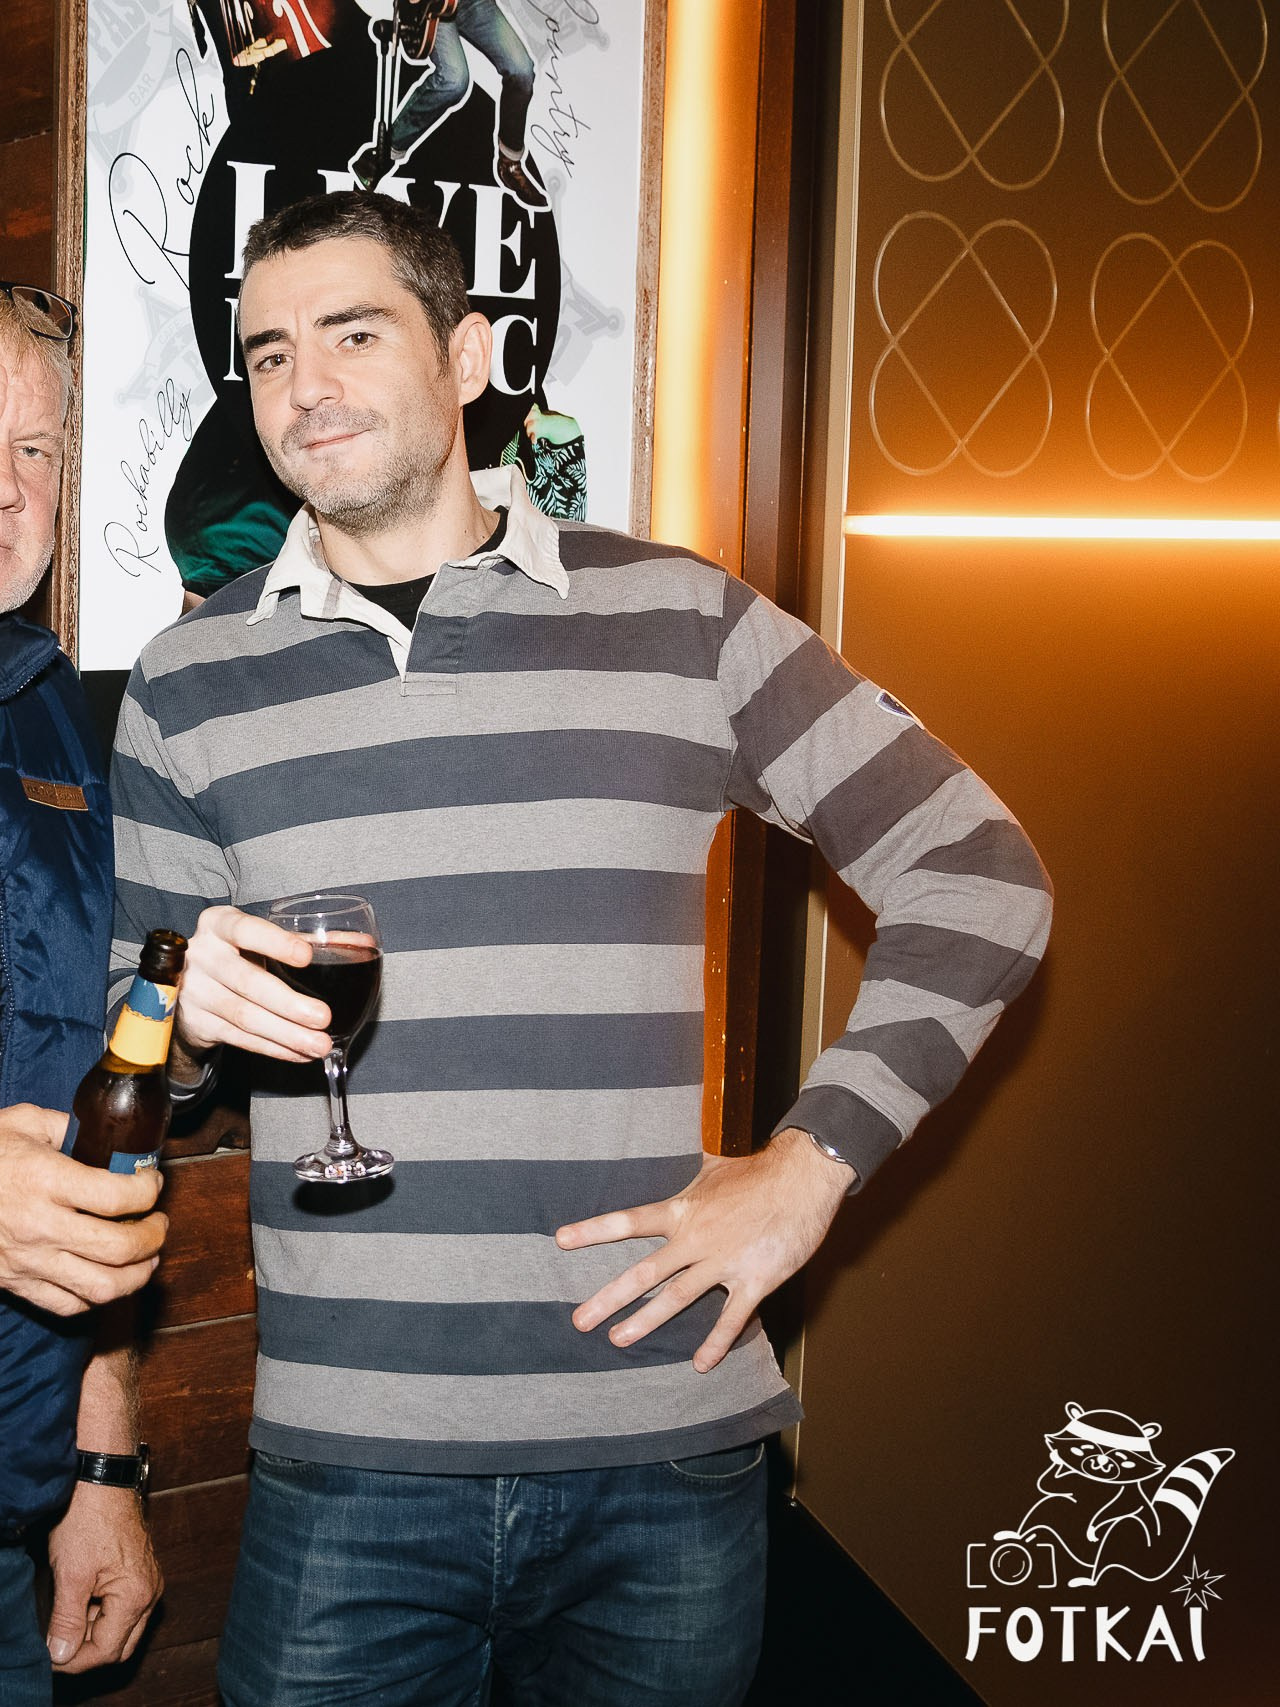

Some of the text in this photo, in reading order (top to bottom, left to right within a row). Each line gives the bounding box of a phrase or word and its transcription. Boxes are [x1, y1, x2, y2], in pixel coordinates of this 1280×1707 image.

[108, 47, 215, 291] Rock
[128, 73, 155, 107] BAR
[104, 378, 192, 578] Rockabilly
